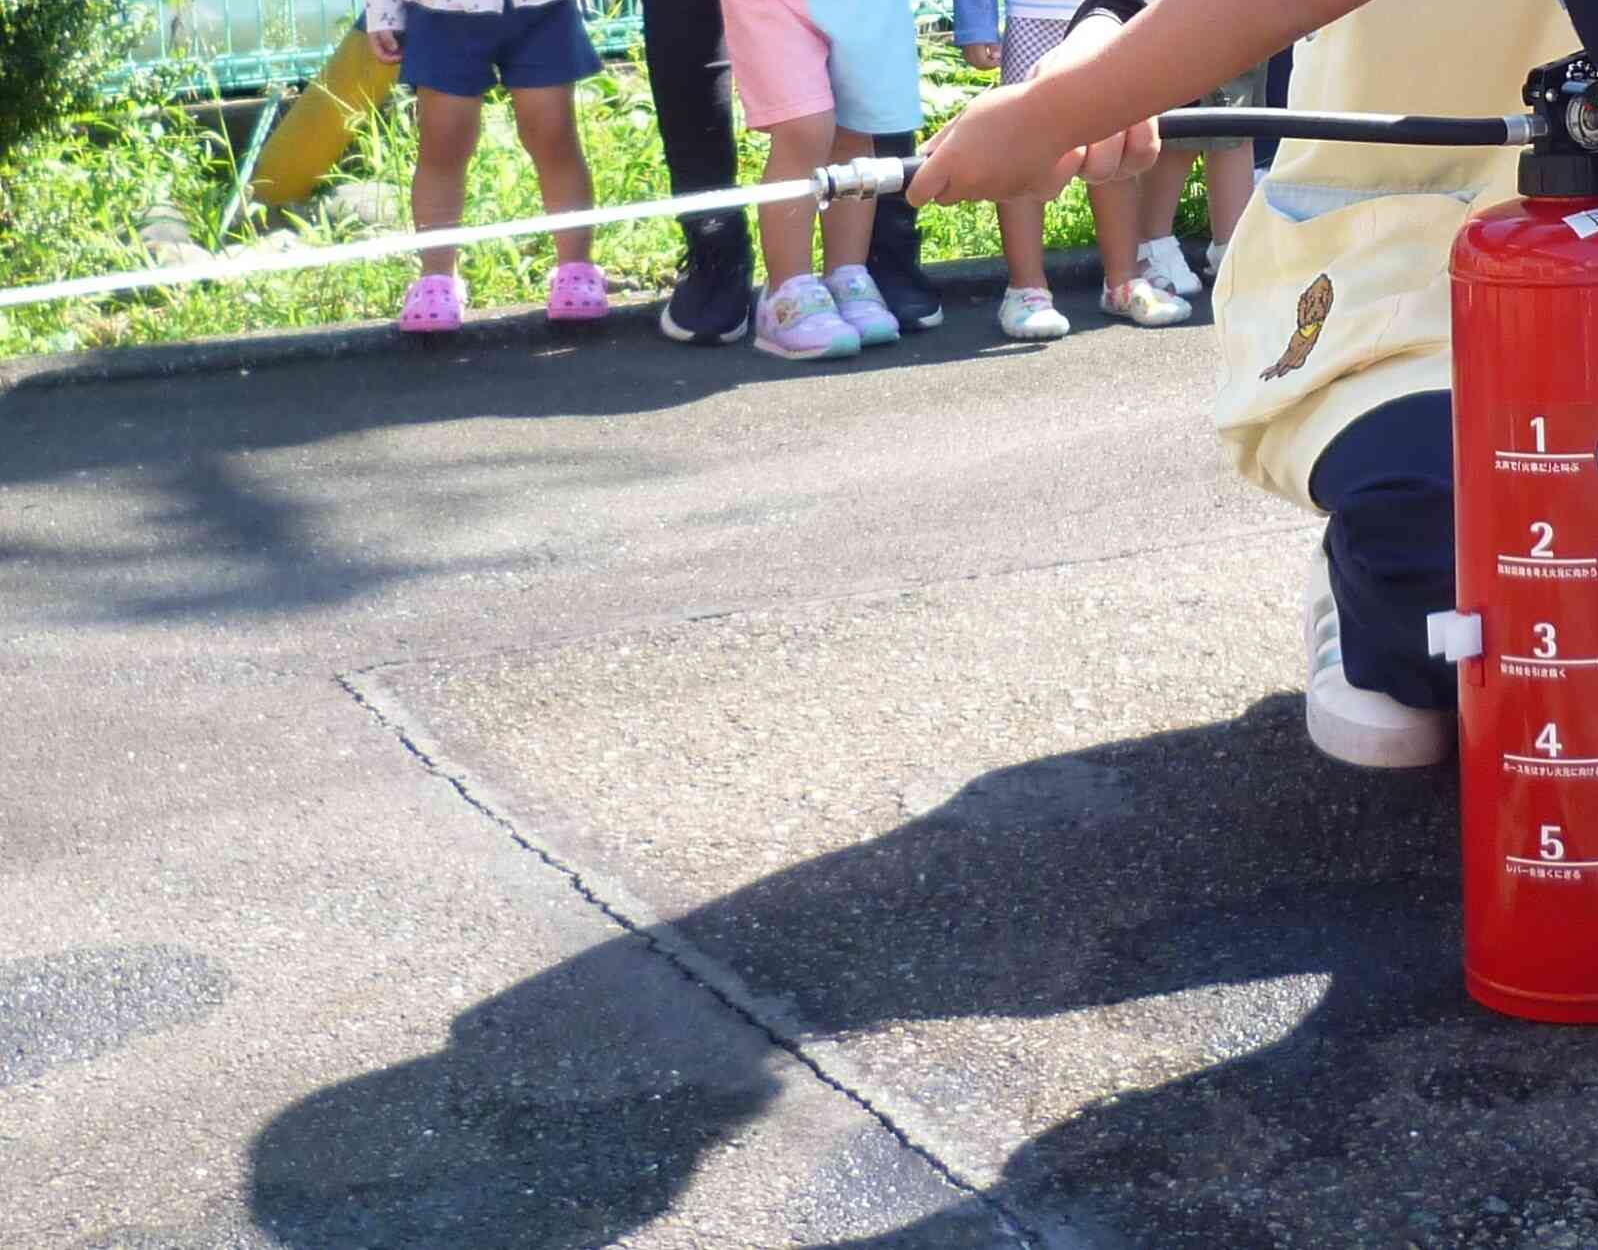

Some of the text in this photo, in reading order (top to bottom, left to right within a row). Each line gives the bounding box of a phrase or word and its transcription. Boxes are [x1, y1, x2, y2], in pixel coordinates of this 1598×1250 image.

[1529, 416, 1546, 452] 1
[1530, 521, 1555, 557] 2
[1533, 622, 1558, 658] 3
[1534, 722, 1563, 758] 4
[1540, 824, 1565, 860] 5
